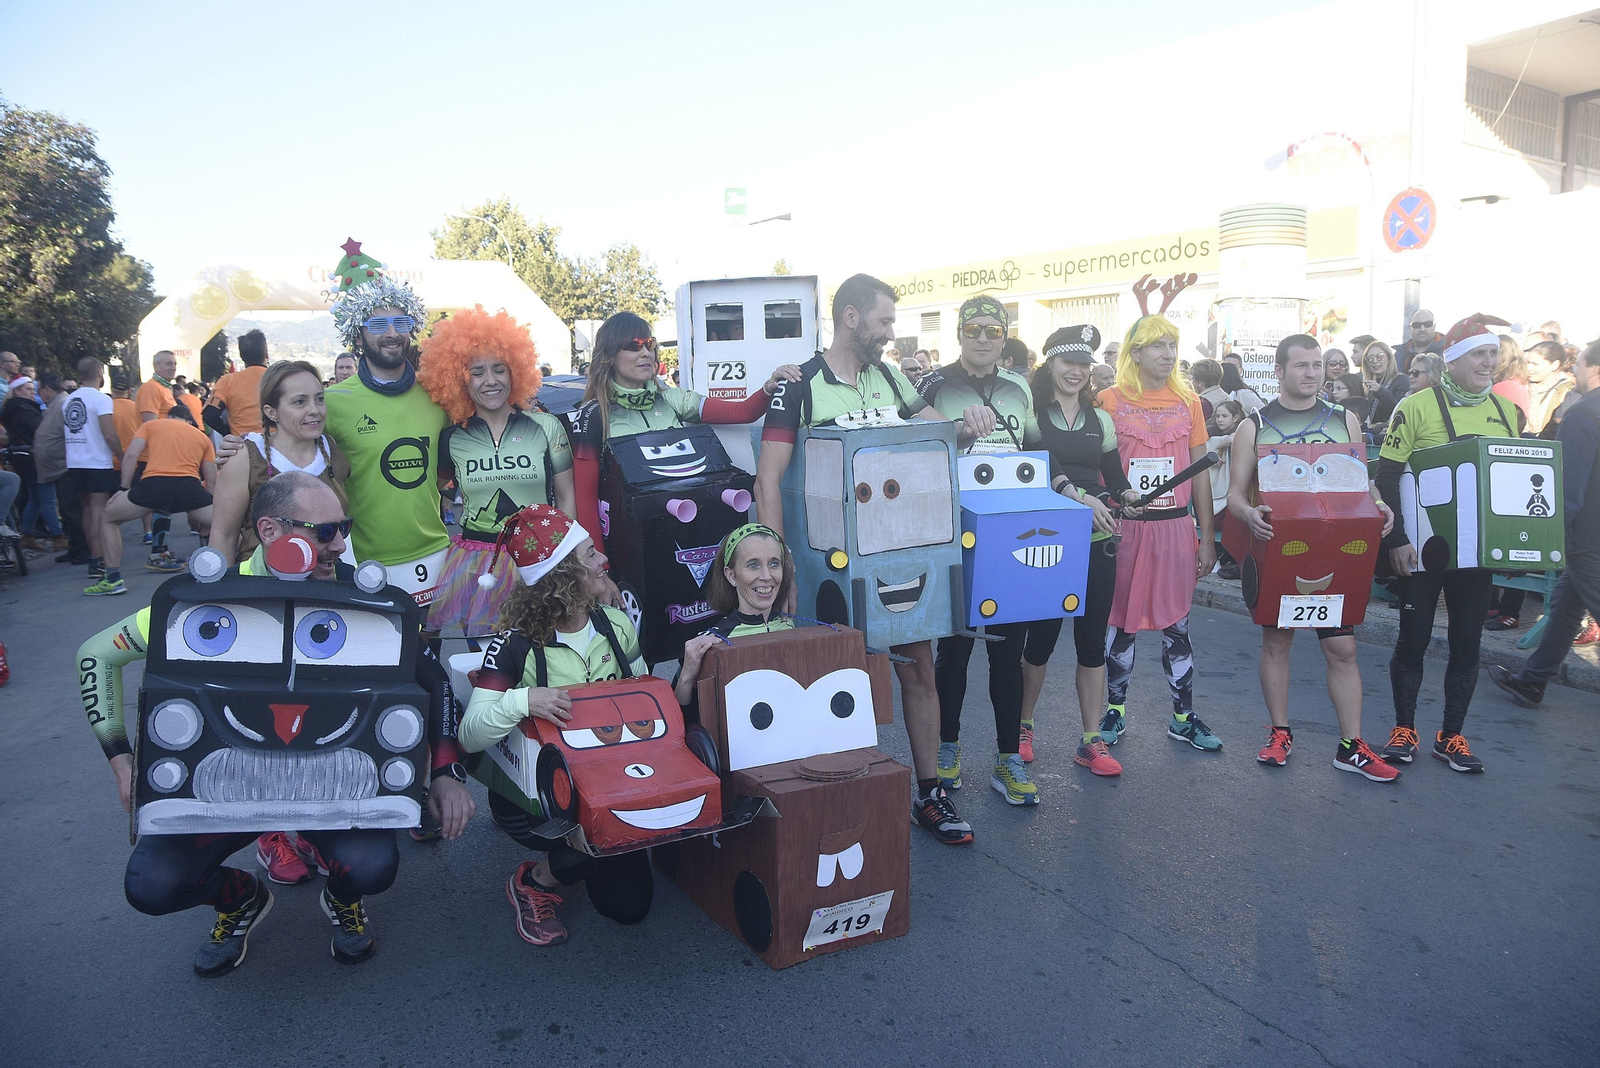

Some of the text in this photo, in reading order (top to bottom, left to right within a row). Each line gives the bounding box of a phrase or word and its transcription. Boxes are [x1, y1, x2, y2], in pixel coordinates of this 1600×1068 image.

[1042, 236, 1210, 282] supermercados
[708, 362, 747, 380] 723
[485, 473, 520, 482] RUNNING
[681, 550, 717, 562] Cars
[414, 563, 429, 583] 9
[1292, 605, 1329, 621] 278
[80, 657, 106, 727] pulso
[105, 671, 115, 701] RUNNING
[108, 702, 116, 720] TRAIL
[631, 765, 646, 777] 1
[822, 913, 871, 935] 419
